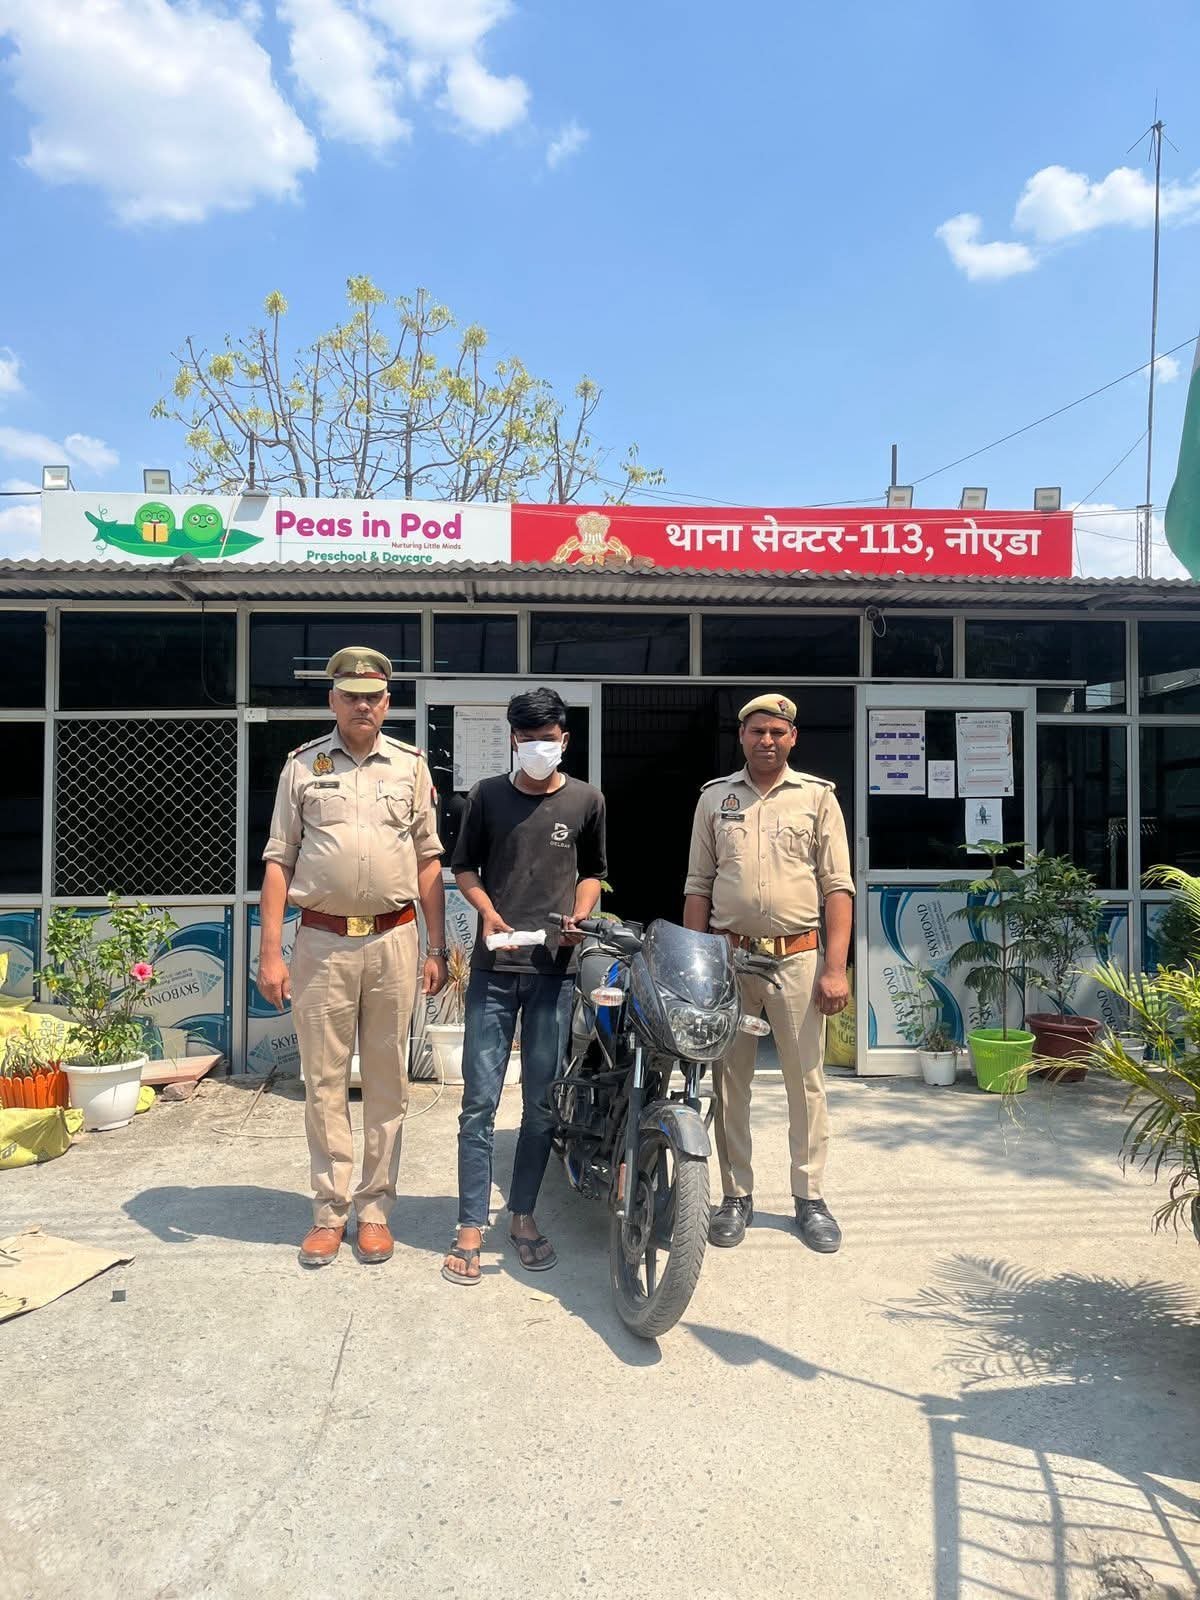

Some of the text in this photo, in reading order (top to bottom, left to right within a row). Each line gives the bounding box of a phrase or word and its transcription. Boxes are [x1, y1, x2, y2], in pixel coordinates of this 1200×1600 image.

[275, 510, 462, 540] Peas in Pod
[666, 515, 1042, 563] थाना सेक्टर-113, नोएडा
[306, 551, 433, 563] Preschool & Daycare
[391, 541, 422, 550] Nurturing
[917, 904, 940, 958] SKYBOND
[883, 967, 905, 1022] SKYOND
